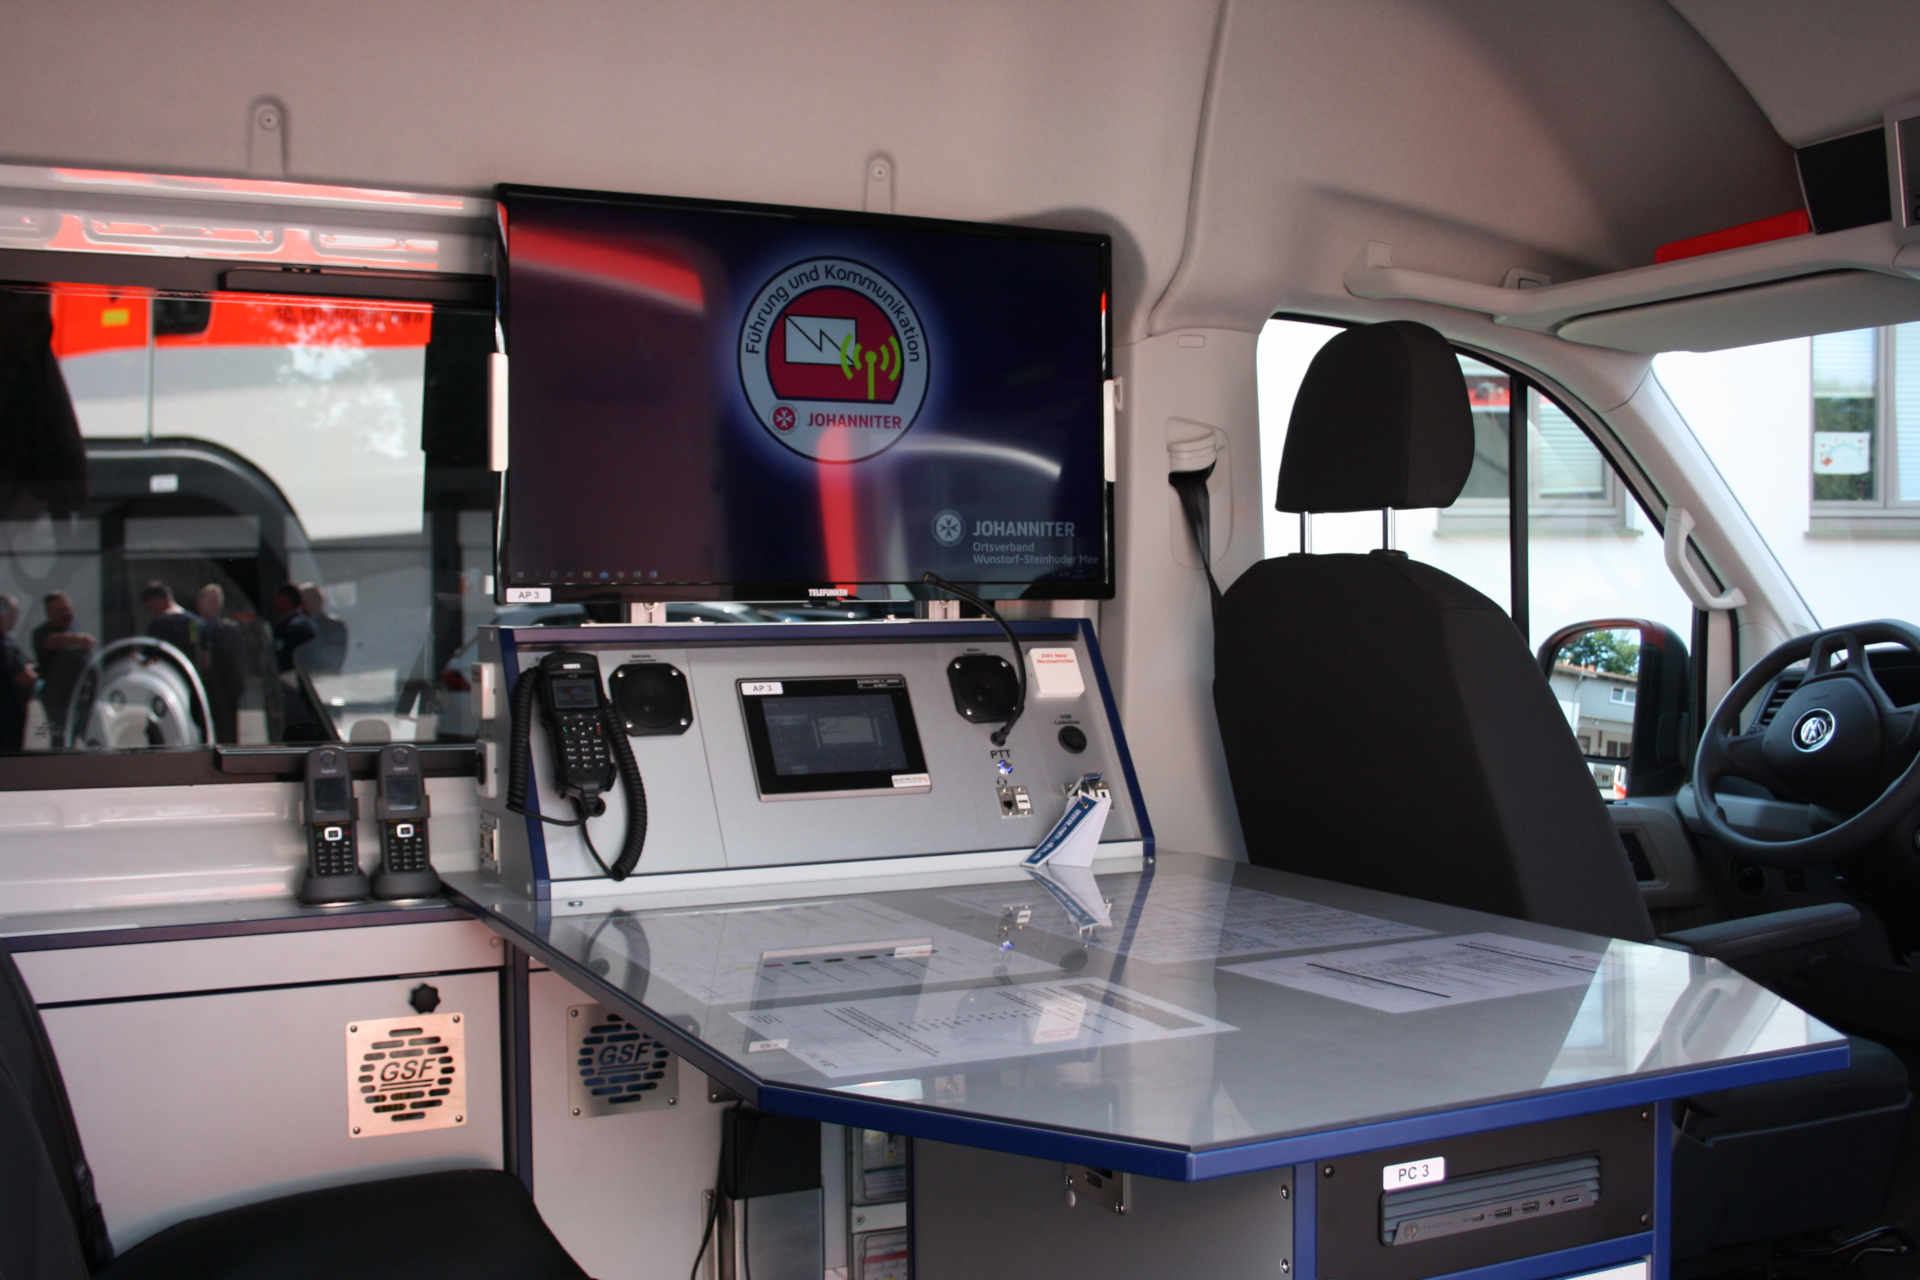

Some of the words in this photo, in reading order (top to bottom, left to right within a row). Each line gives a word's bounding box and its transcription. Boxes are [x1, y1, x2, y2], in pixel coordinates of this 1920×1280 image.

[746, 285, 790, 354] Führung
[789, 265, 820, 290] und
[824, 264, 920, 363] Kommunikation
[808, 412, 902, 429] JOHANNITER
[972, 520, 1076, 537] JOHANNITER
[972, 542, 1034, 553] Ortsverband
[518, 591, 532, 600] AP
[753, 684, 765, 693] AP
[990, 750, 1010, 759] PTT
[598, 1041, 651, 1065] GSF
[379, 1058, 436, 1083] GSF
[1398, 1166, 1417, 1182] PC
[1422, 1164, 1430, 1178] 3
